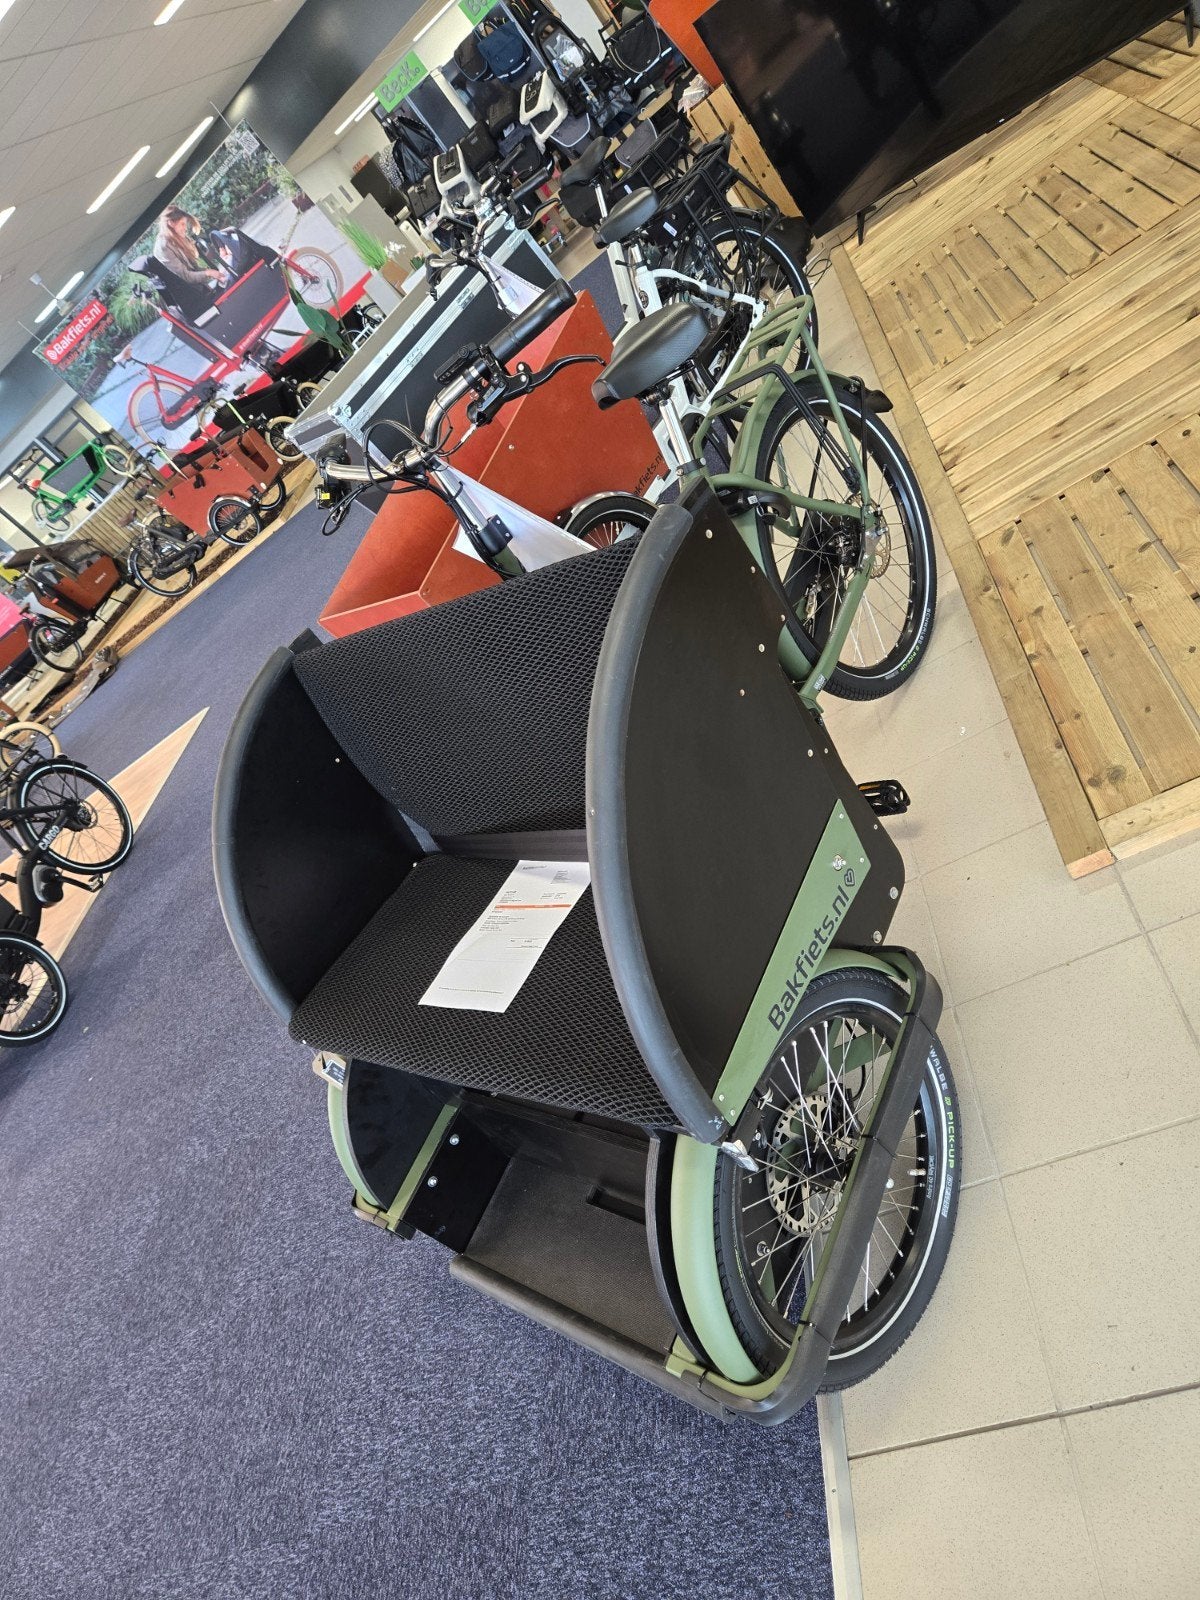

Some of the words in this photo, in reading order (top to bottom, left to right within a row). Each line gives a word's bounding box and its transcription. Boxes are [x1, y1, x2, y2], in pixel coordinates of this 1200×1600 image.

[633, 452, 665, 496] akfiets.nl
[39, 825, 60, 850] CARGO
[768, 885, 850, 1031] Bakfiets.nl
[930, 1045, 948, 1090] WALBE
[946, 1111, 955, 1169] PICK-UP
